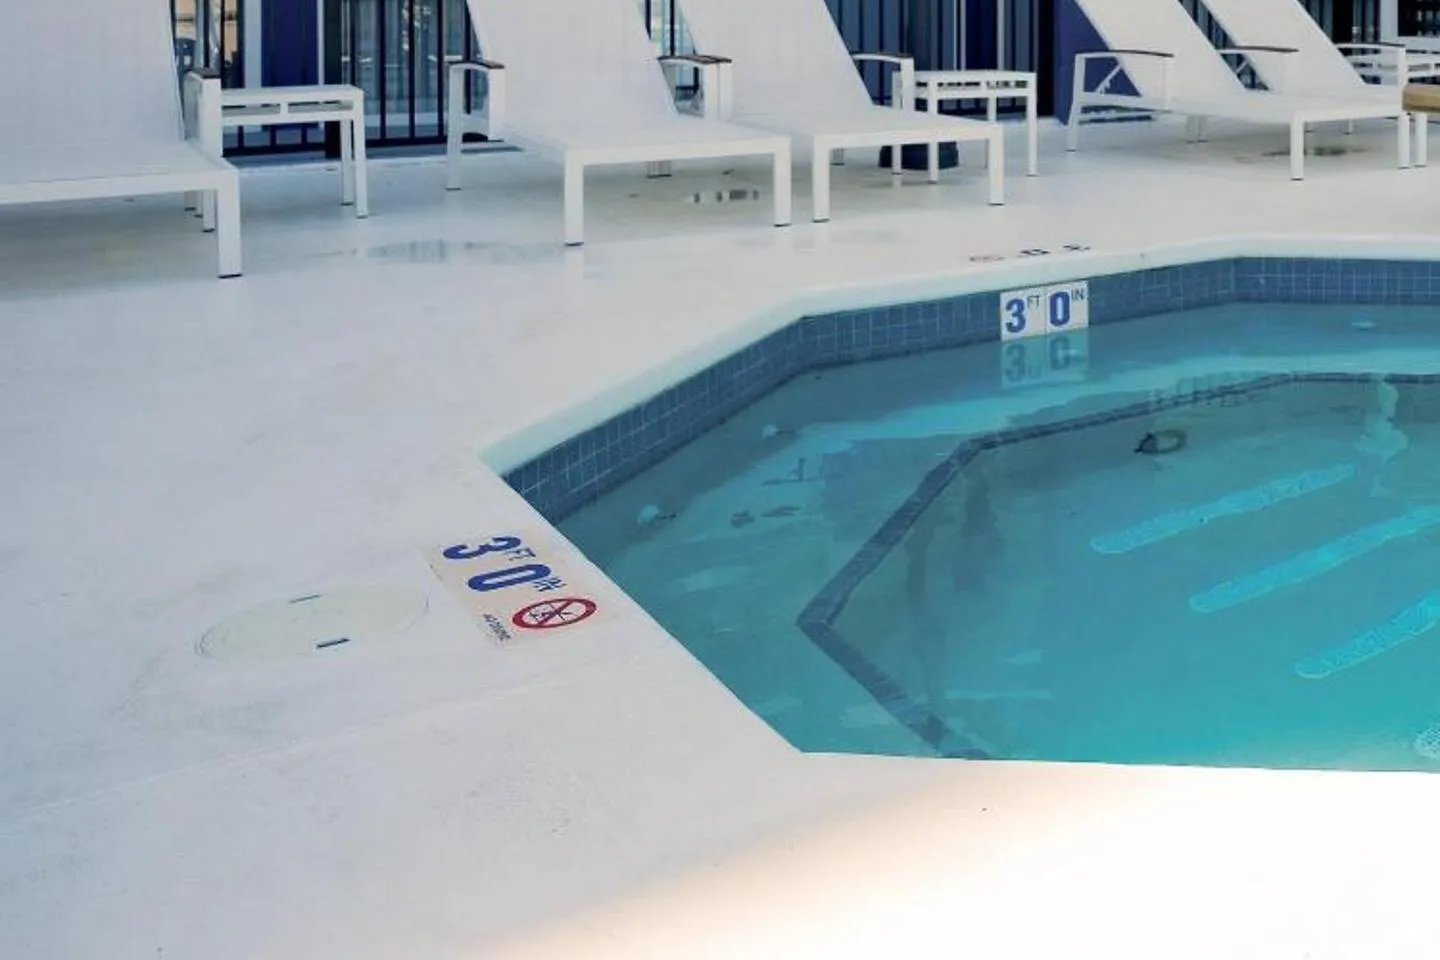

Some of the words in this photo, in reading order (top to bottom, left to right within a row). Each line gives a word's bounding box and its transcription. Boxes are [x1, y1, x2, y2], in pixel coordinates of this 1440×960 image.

[1005, 298, 1026, 333] 3
[1049, 291, 1070, 327] 0
[1071, 288, 1085, 301] IN
[443, 536, 521, 559] 3
[467, 564, 551, 591] 0
